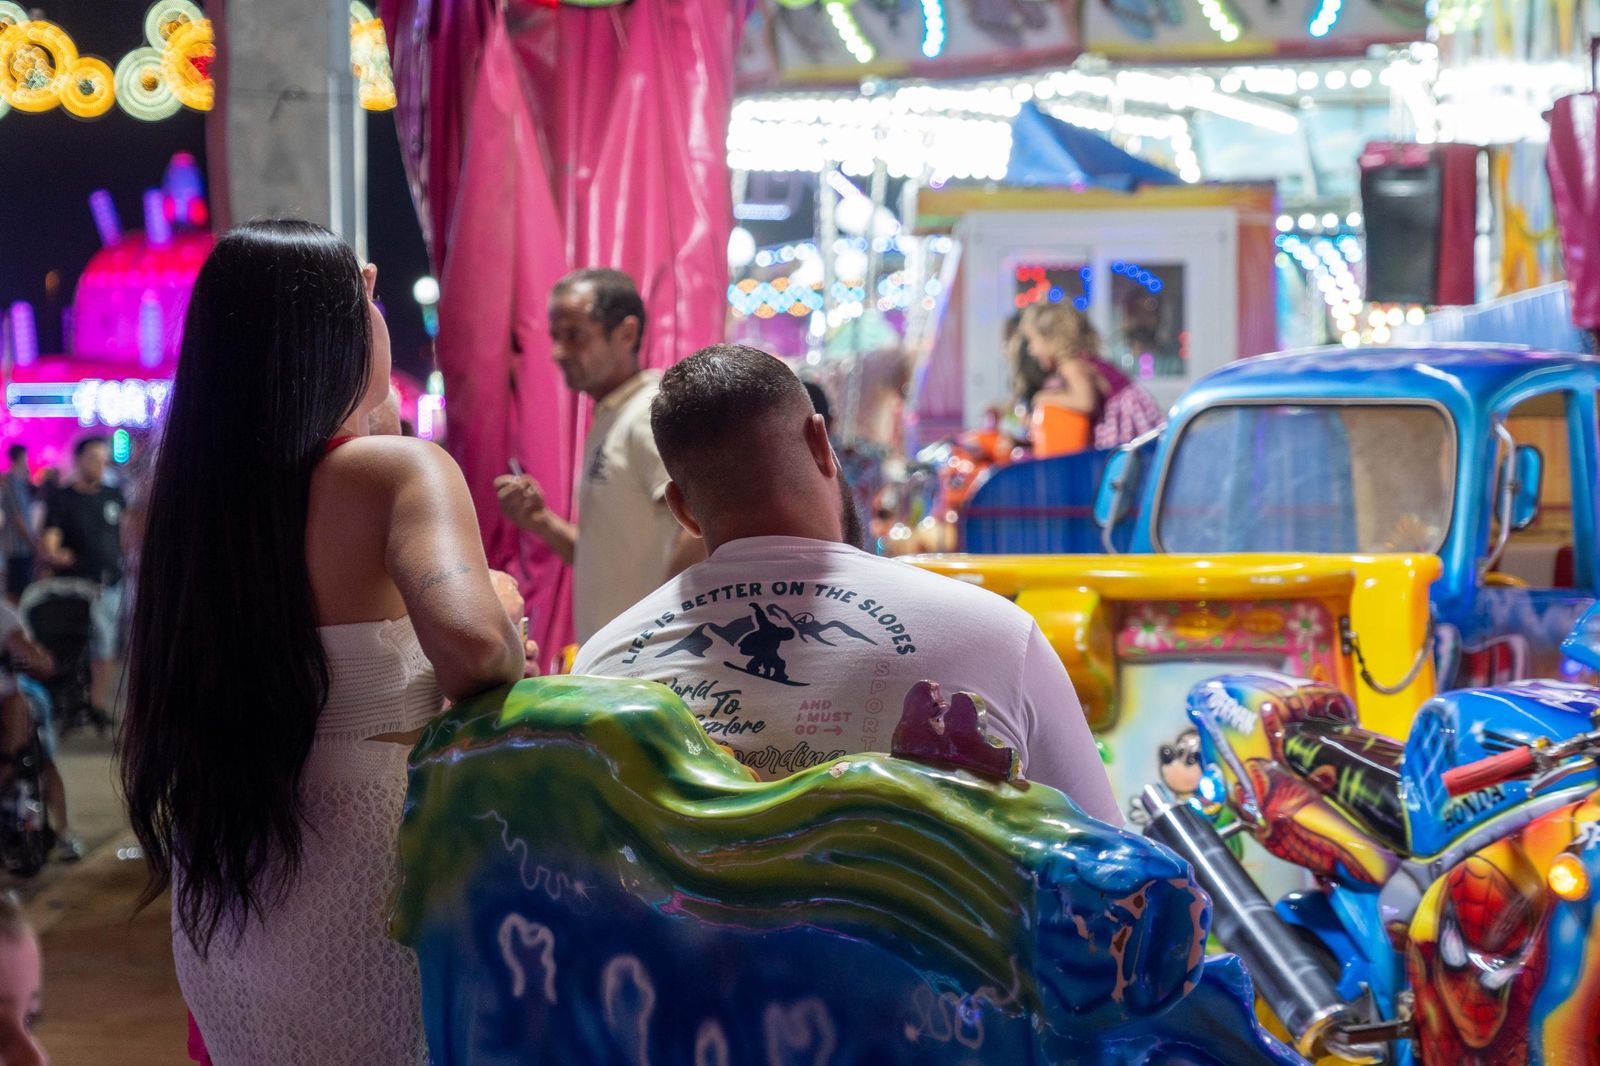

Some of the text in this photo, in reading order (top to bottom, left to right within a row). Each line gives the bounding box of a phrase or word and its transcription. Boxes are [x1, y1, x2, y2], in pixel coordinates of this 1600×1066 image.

[622, 581, 917, 664] LIFE IS BETTER ON THE SLOPES
[710, 689, 743, 718] To
[800, 700, 832, 711] AND
[807, 712, 852, 723] MUST
[795, 724, 817, 735] GO
